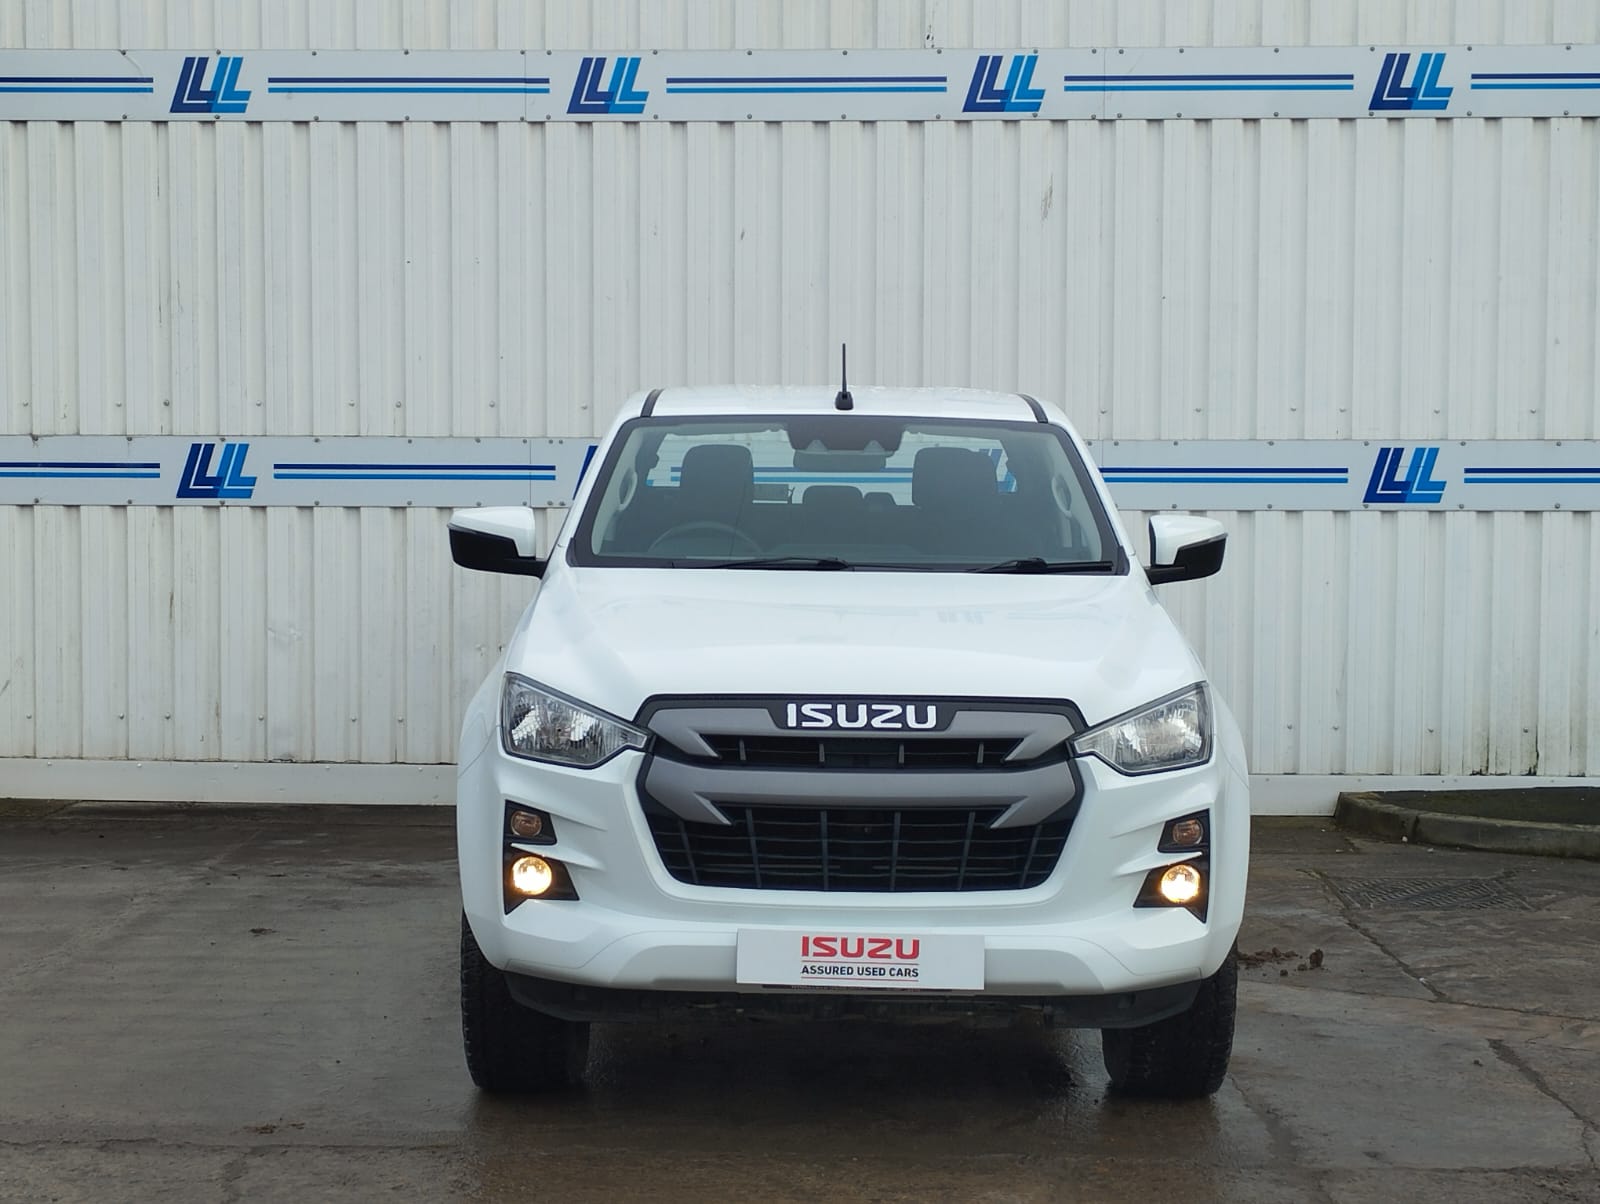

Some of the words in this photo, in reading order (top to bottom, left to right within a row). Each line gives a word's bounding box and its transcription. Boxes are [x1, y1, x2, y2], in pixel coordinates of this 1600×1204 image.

[786, 703, 937, 729] ISUZU
[801, 935, 920, 959] ISUZU
[801, 965, 854, 976] ASSURED
[857, 966, 885, 977] USED
[889, 967, 919, 978] CARS
